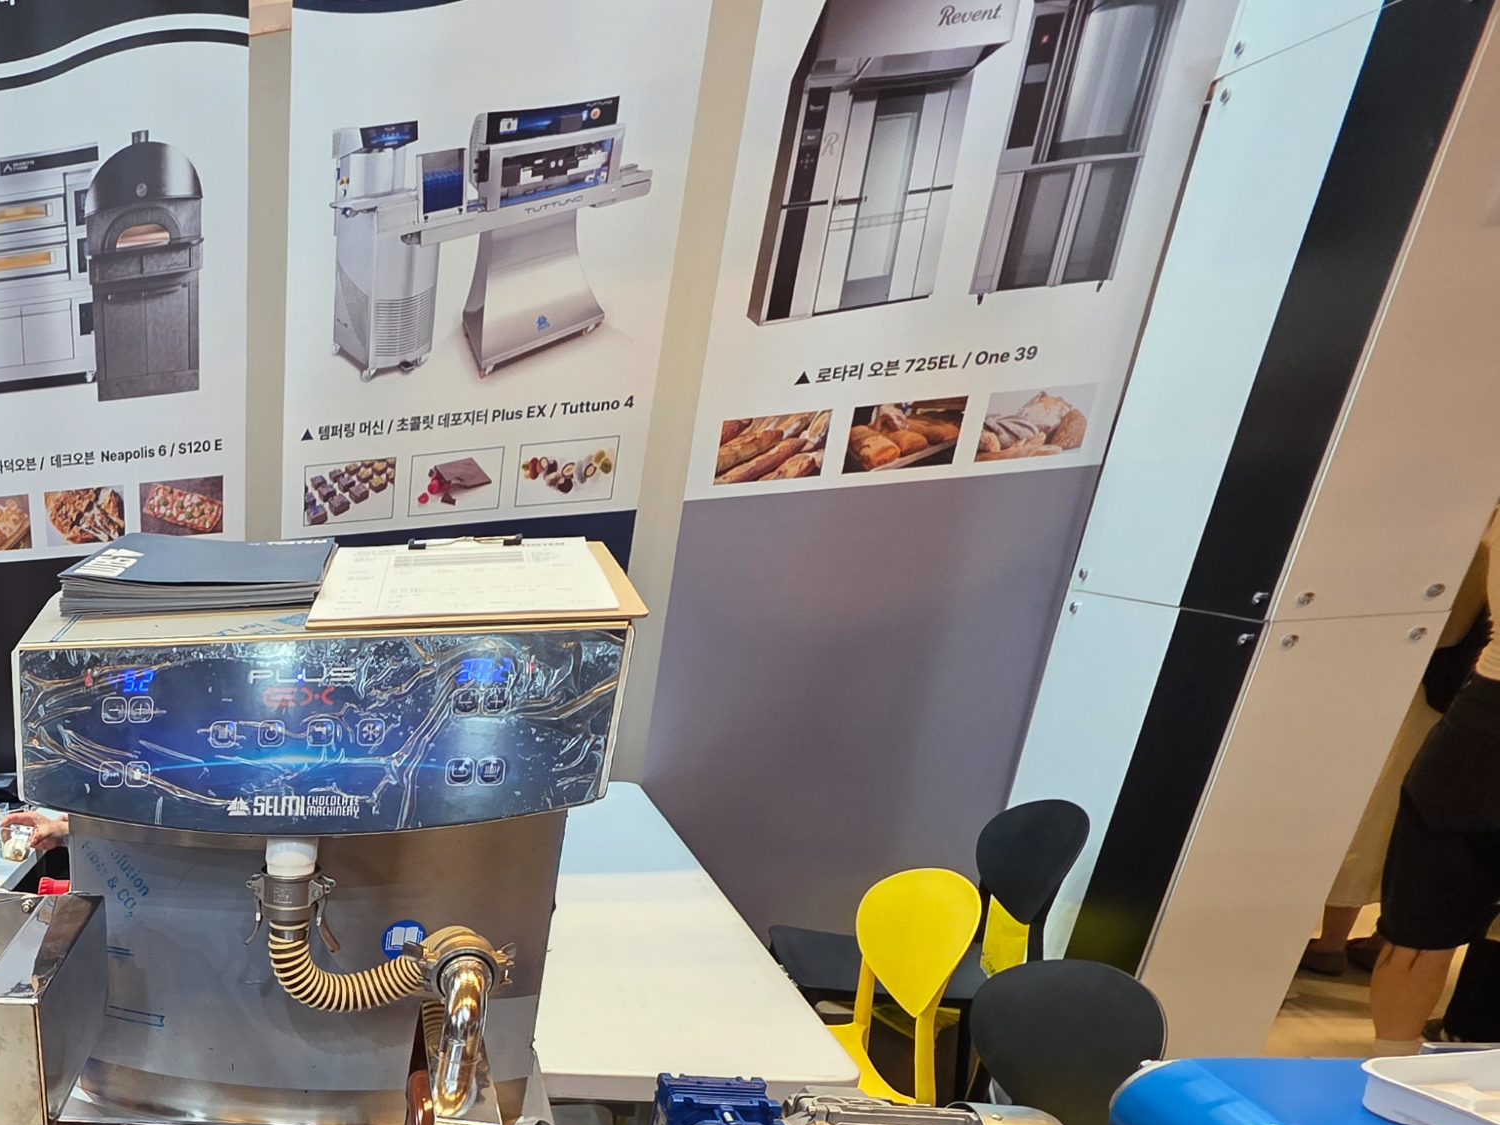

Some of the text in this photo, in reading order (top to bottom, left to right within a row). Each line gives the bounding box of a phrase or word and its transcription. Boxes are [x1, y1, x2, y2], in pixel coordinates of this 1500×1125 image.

[938, 3, 1002, 27] Revent
[815, 363, 864, 384] 로타리
[867, 360, 900, 378] 오븐
[904, 353, 959, 375] 725EL
[975, 350, 1010, 366] One
[1014, 345, 1038, 361] 39
[318, 422, 356, 441] 템퍼링
[359, 419, 384, 437] 머신
[396, 414, 435, 433] 초콜릿
[437, 408, 488, 428] 데포지터
[492, 406, 523, 423] Plus
[526, 405, 547, 419] EX
[561, 400, 620, 415] Tuttuno
[624, 395, 634, 408] 4
[50, 450, 95, 469] 데크오븐
[101, 445, 155, 464] Neapolis
[158, 444, 167, 457] 6
[178, 440, 211, 455] S120
[214, 439, 222, 451] E
[249, 669, 356, 684] PLUS
[253, 795, 304, 817] SELMI
[306, 805, 360, 817] MACHINERY
[307, 796, 359, 806] CHOCOLATE
